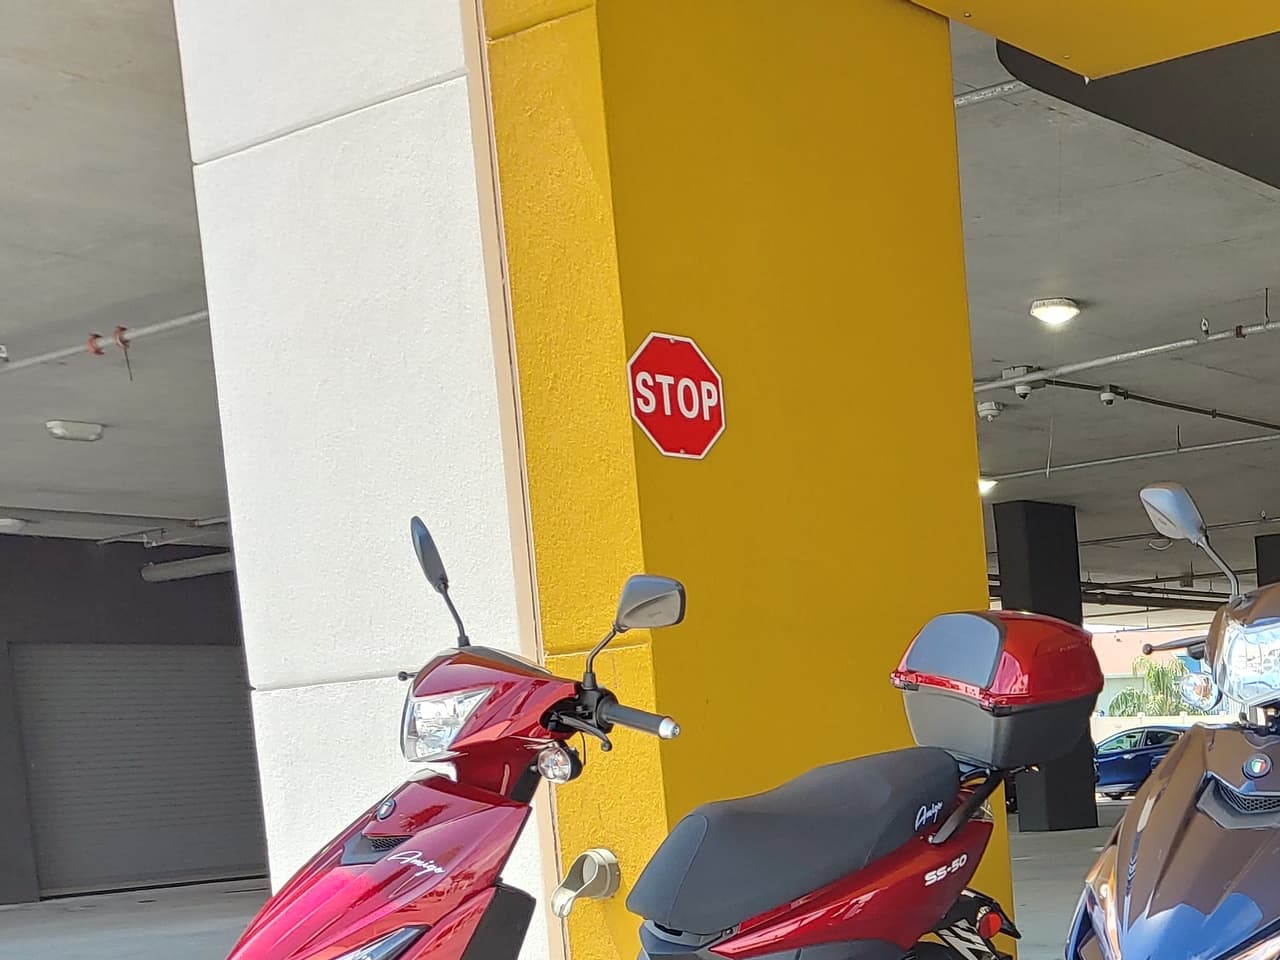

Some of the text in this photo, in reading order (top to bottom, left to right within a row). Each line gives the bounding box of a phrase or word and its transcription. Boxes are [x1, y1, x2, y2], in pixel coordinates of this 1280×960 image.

[635, 371, 718, 421] STOP
[387, 850, 446, 877] Amigo
[924, 854, 968, 887] SS-50
